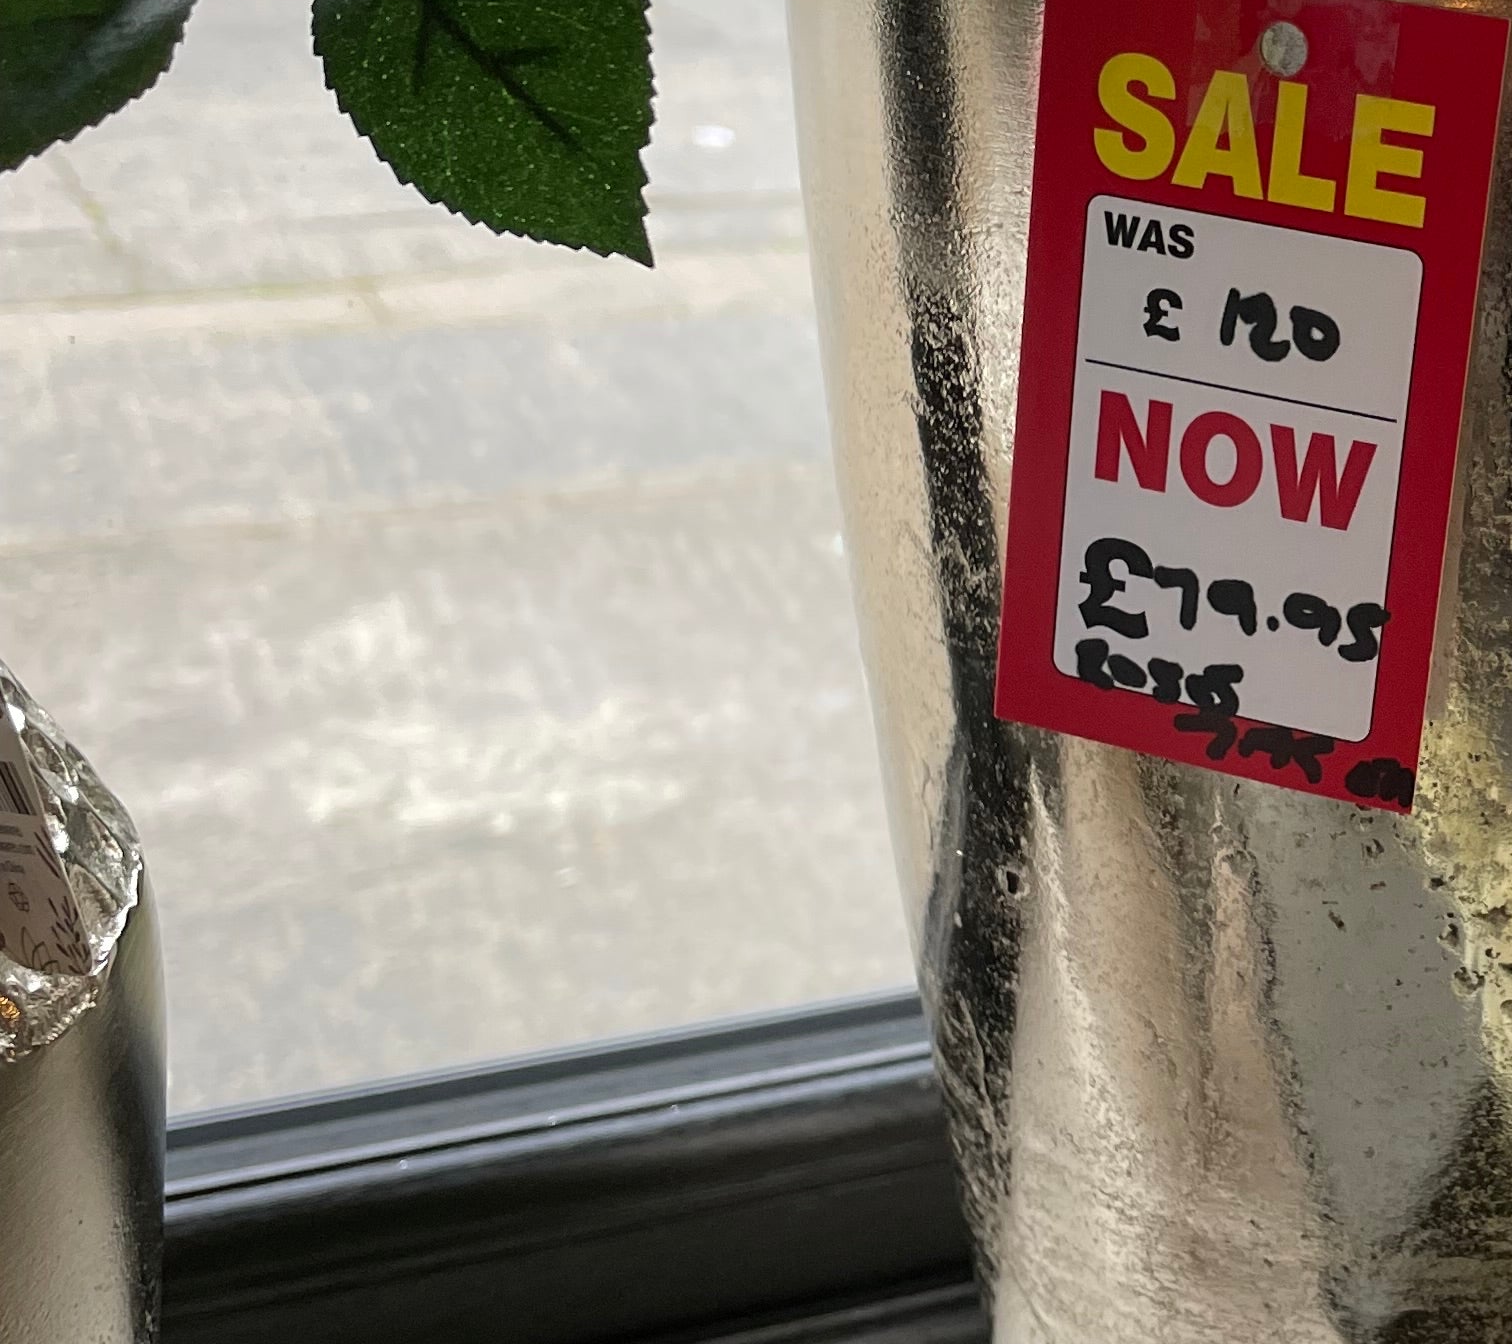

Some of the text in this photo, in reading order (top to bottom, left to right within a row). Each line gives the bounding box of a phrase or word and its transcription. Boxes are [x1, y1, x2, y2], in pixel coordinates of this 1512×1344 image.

[1094, 53, 1436, 228] SALE
[1103, 211, 1195, 258] WAS
[1094, 390, 1378, 532] NOW
